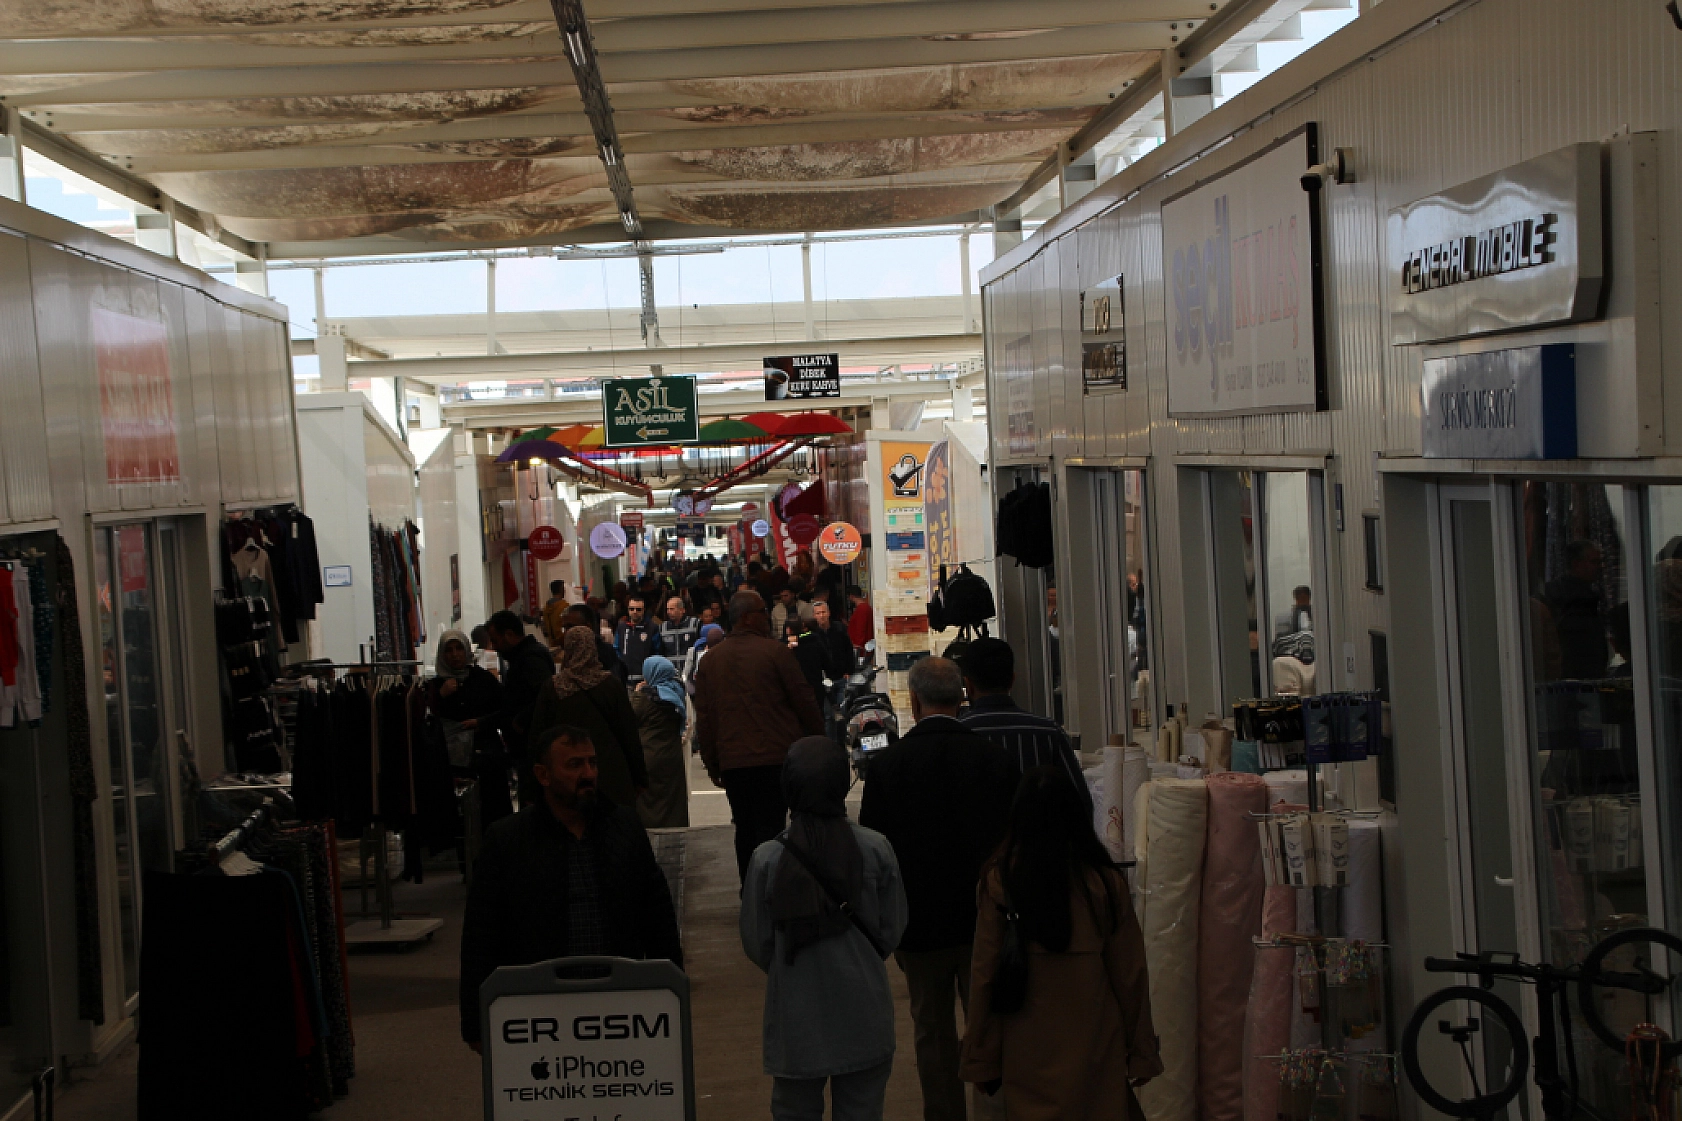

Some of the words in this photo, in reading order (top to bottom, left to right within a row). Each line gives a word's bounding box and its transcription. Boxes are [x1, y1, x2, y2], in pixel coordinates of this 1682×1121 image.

[1478, 212, 1558, 278] MOBILE
[1440, 383, 1472, 431] SERVİS
[502, 1017, 559, 1044] ER
[573, 1012, 670, 1040] GSM
[555, 1055, 645, 1079] iPhone
[503, 1082, 587, 1102] TEKNİK
[592, 1079, 674, 1098] SERVİS
